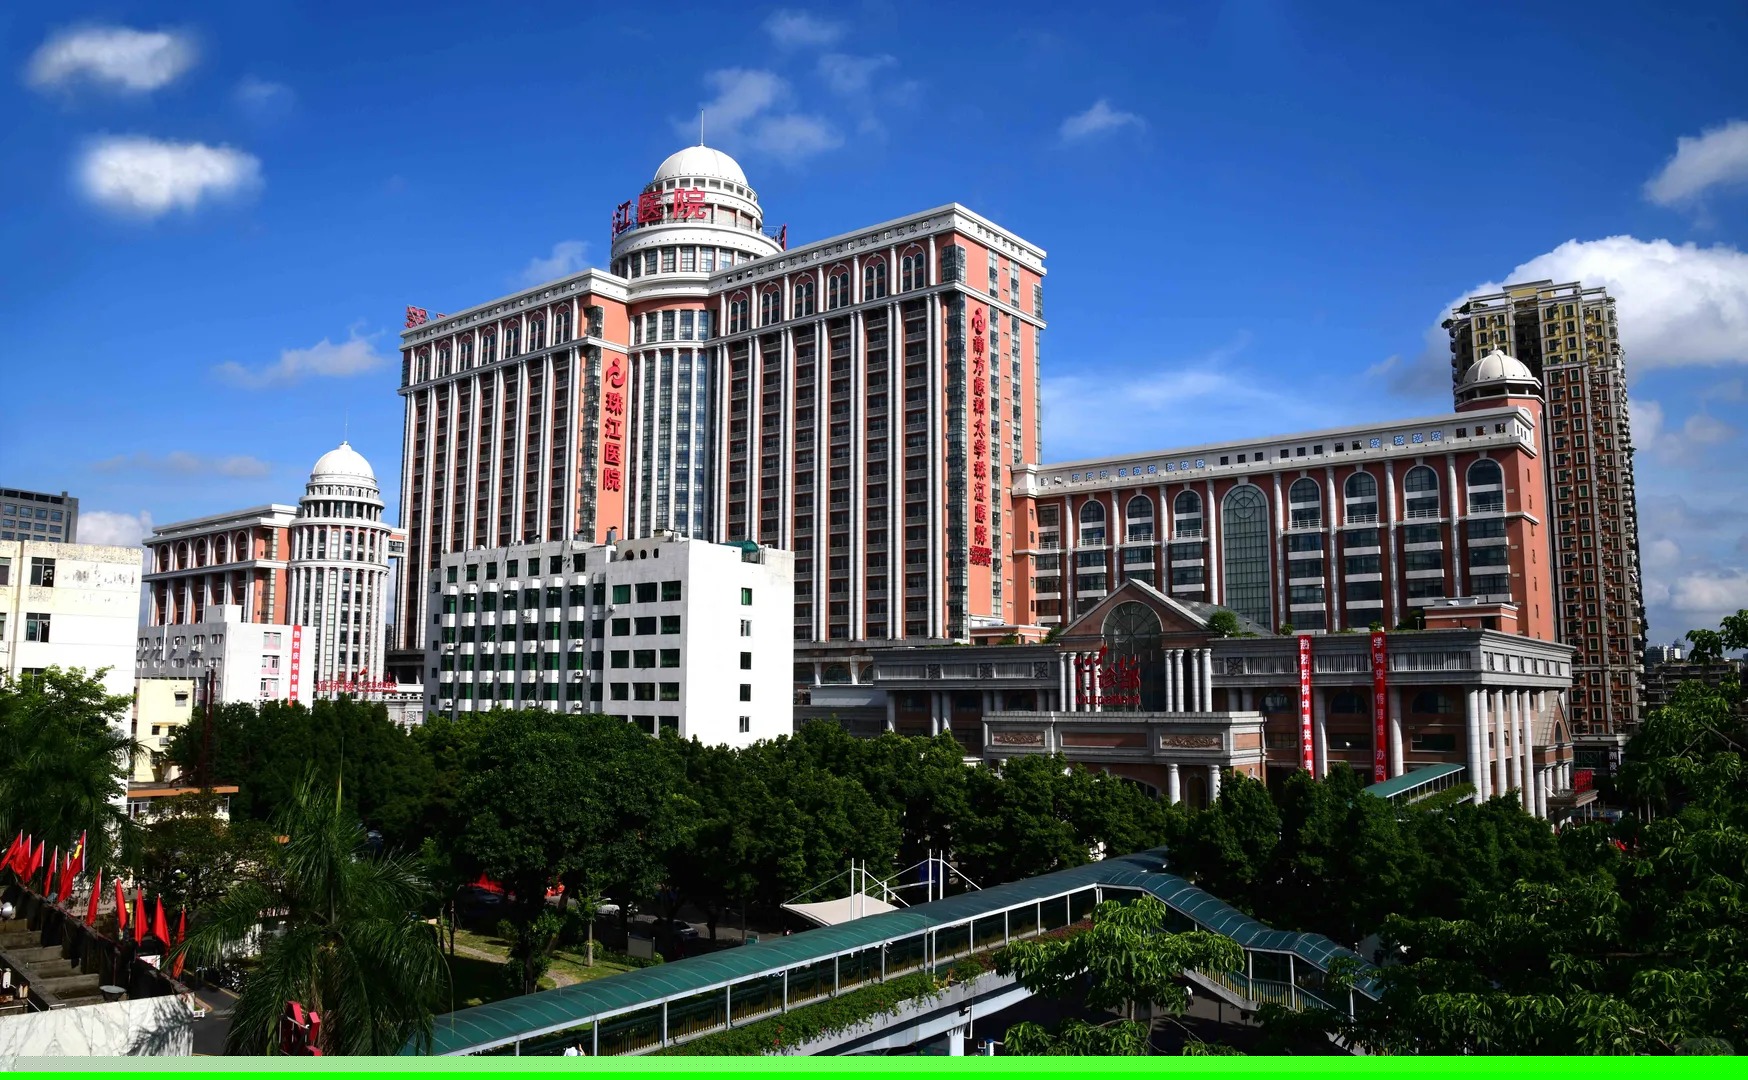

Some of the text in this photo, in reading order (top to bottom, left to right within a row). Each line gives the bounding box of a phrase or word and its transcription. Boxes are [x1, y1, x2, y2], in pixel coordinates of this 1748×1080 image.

[612, 187, 706, 244] 江医院
[603, 391, 623, 492] 珠江医院
[1076, 667, 1141, 691] 门诊部
